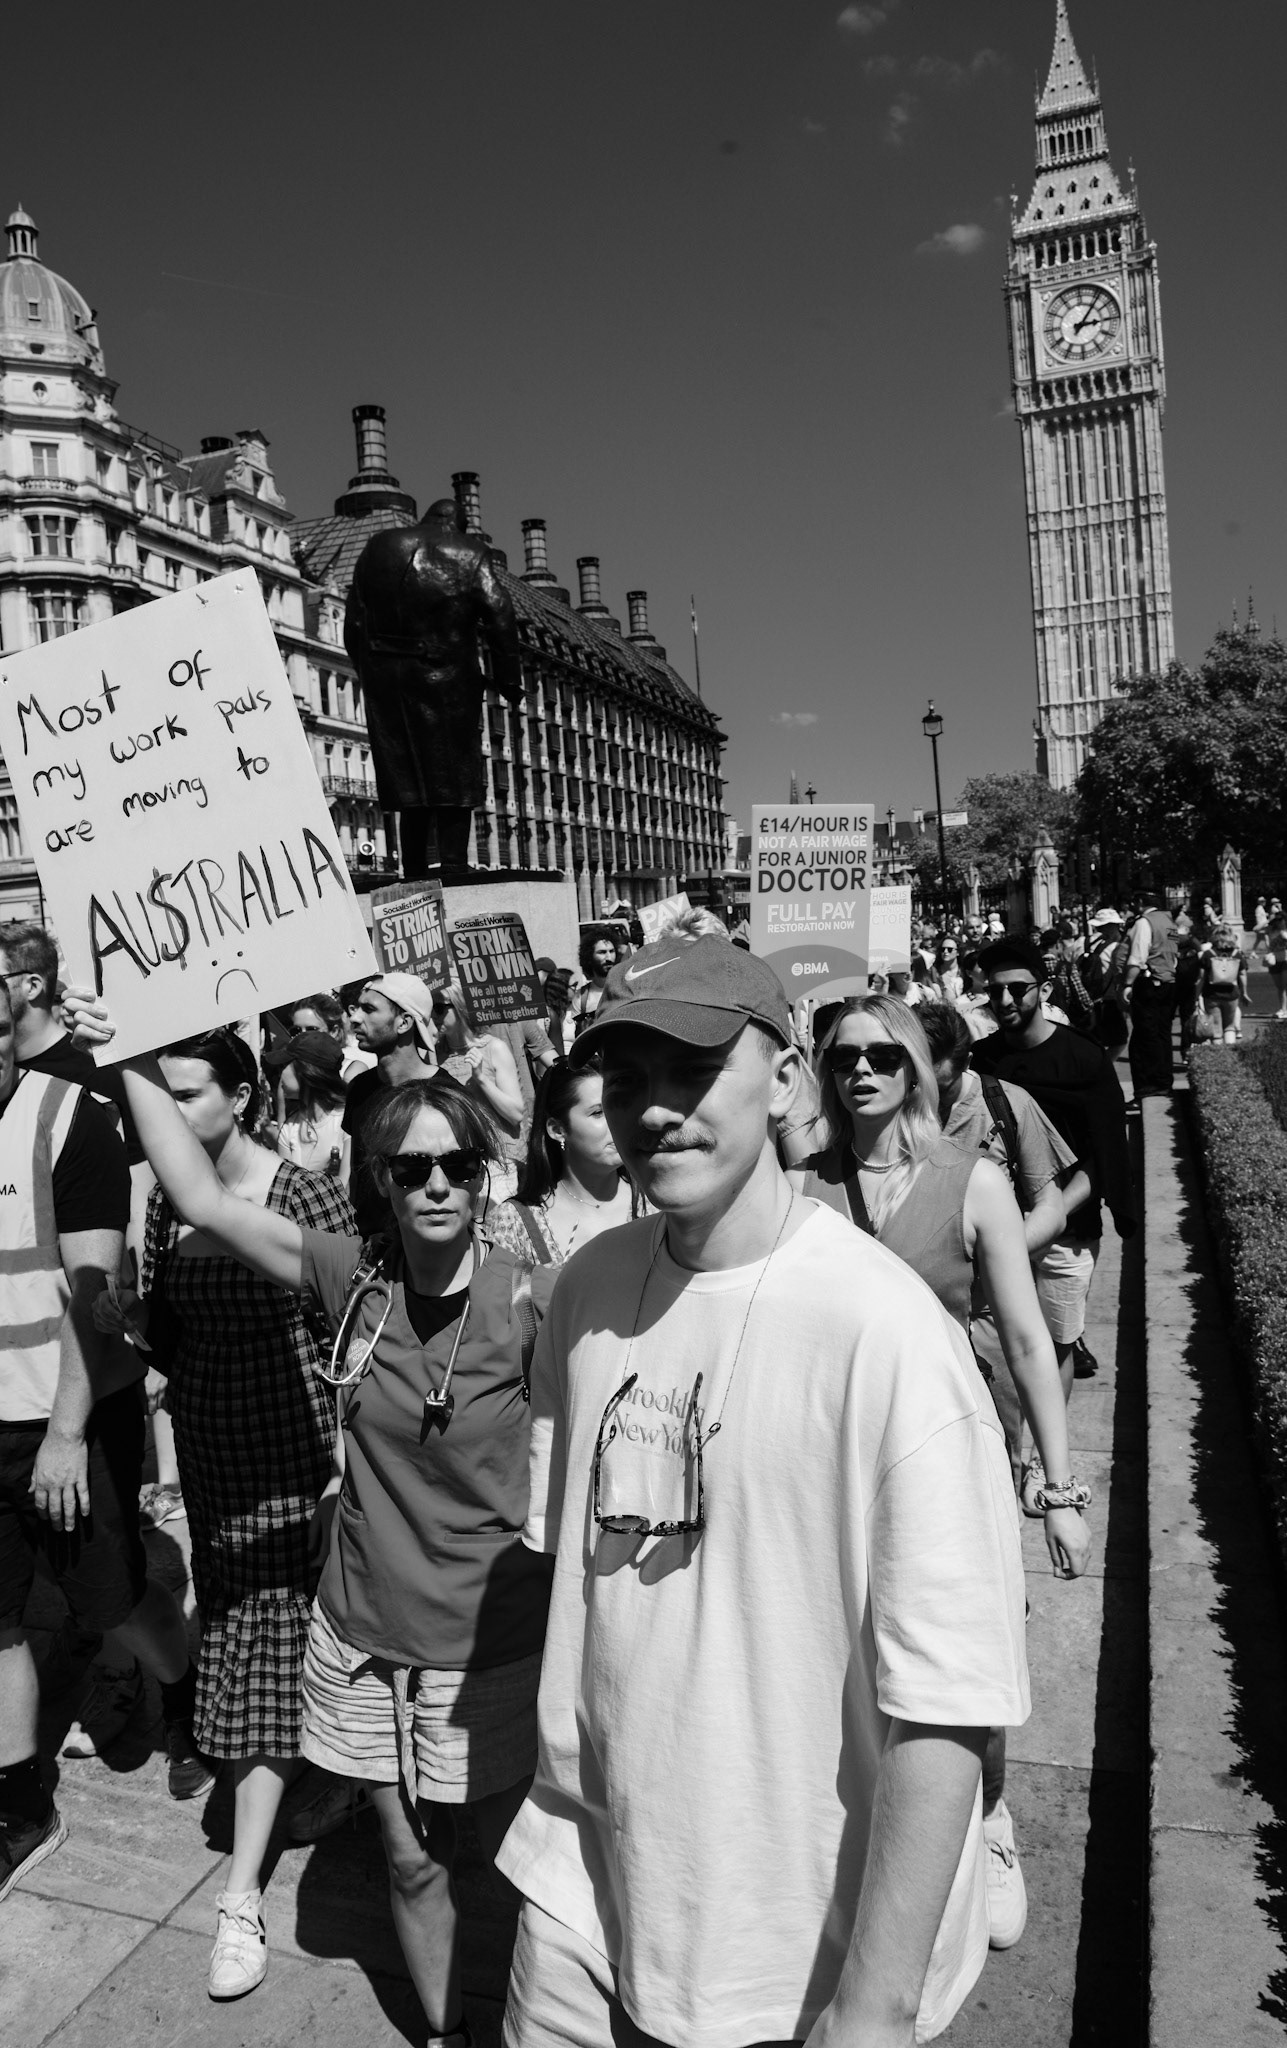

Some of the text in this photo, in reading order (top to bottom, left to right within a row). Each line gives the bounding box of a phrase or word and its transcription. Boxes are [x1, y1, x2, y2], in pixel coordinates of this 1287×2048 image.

[17, 670, 121, 755] Most
[33, 687, 272, 801] my work pals
[45, 747, 270, 854] are moving to
[759, 815, 868, 833] £14/HOUR IS
[758, 834, 867, 849] NOT A FAIR WAGE
[758, 850, 867, 868] FOR A JUNIOR
[758, 867, 866, 893] DOCTOR
[383, 894, 433, 915] Socialist Worker
[640, 896, 684, 932] PAY
[767, 902, 856, 922] FULL PAY
[381, 902, 440, 943] STRIKE
[455, 915, 515, 929] Socialist Worker
[767, 921, 855, 933] RESTORATION NOW
[384, 924, 444, 967] TO WIN
[453, 926, 528, 958] STRIKE
[416, 957, 431, 972] need
[458, 951, 535, 984] TO WIN
[803, 962, 829, 975] BMA
[469, 982, 518, 998] We all need
[473, 994, 515, 1009] a pay rise
[476, 1006, 539, 1022] Strike together
[615, 1408, 659, 1444] New
